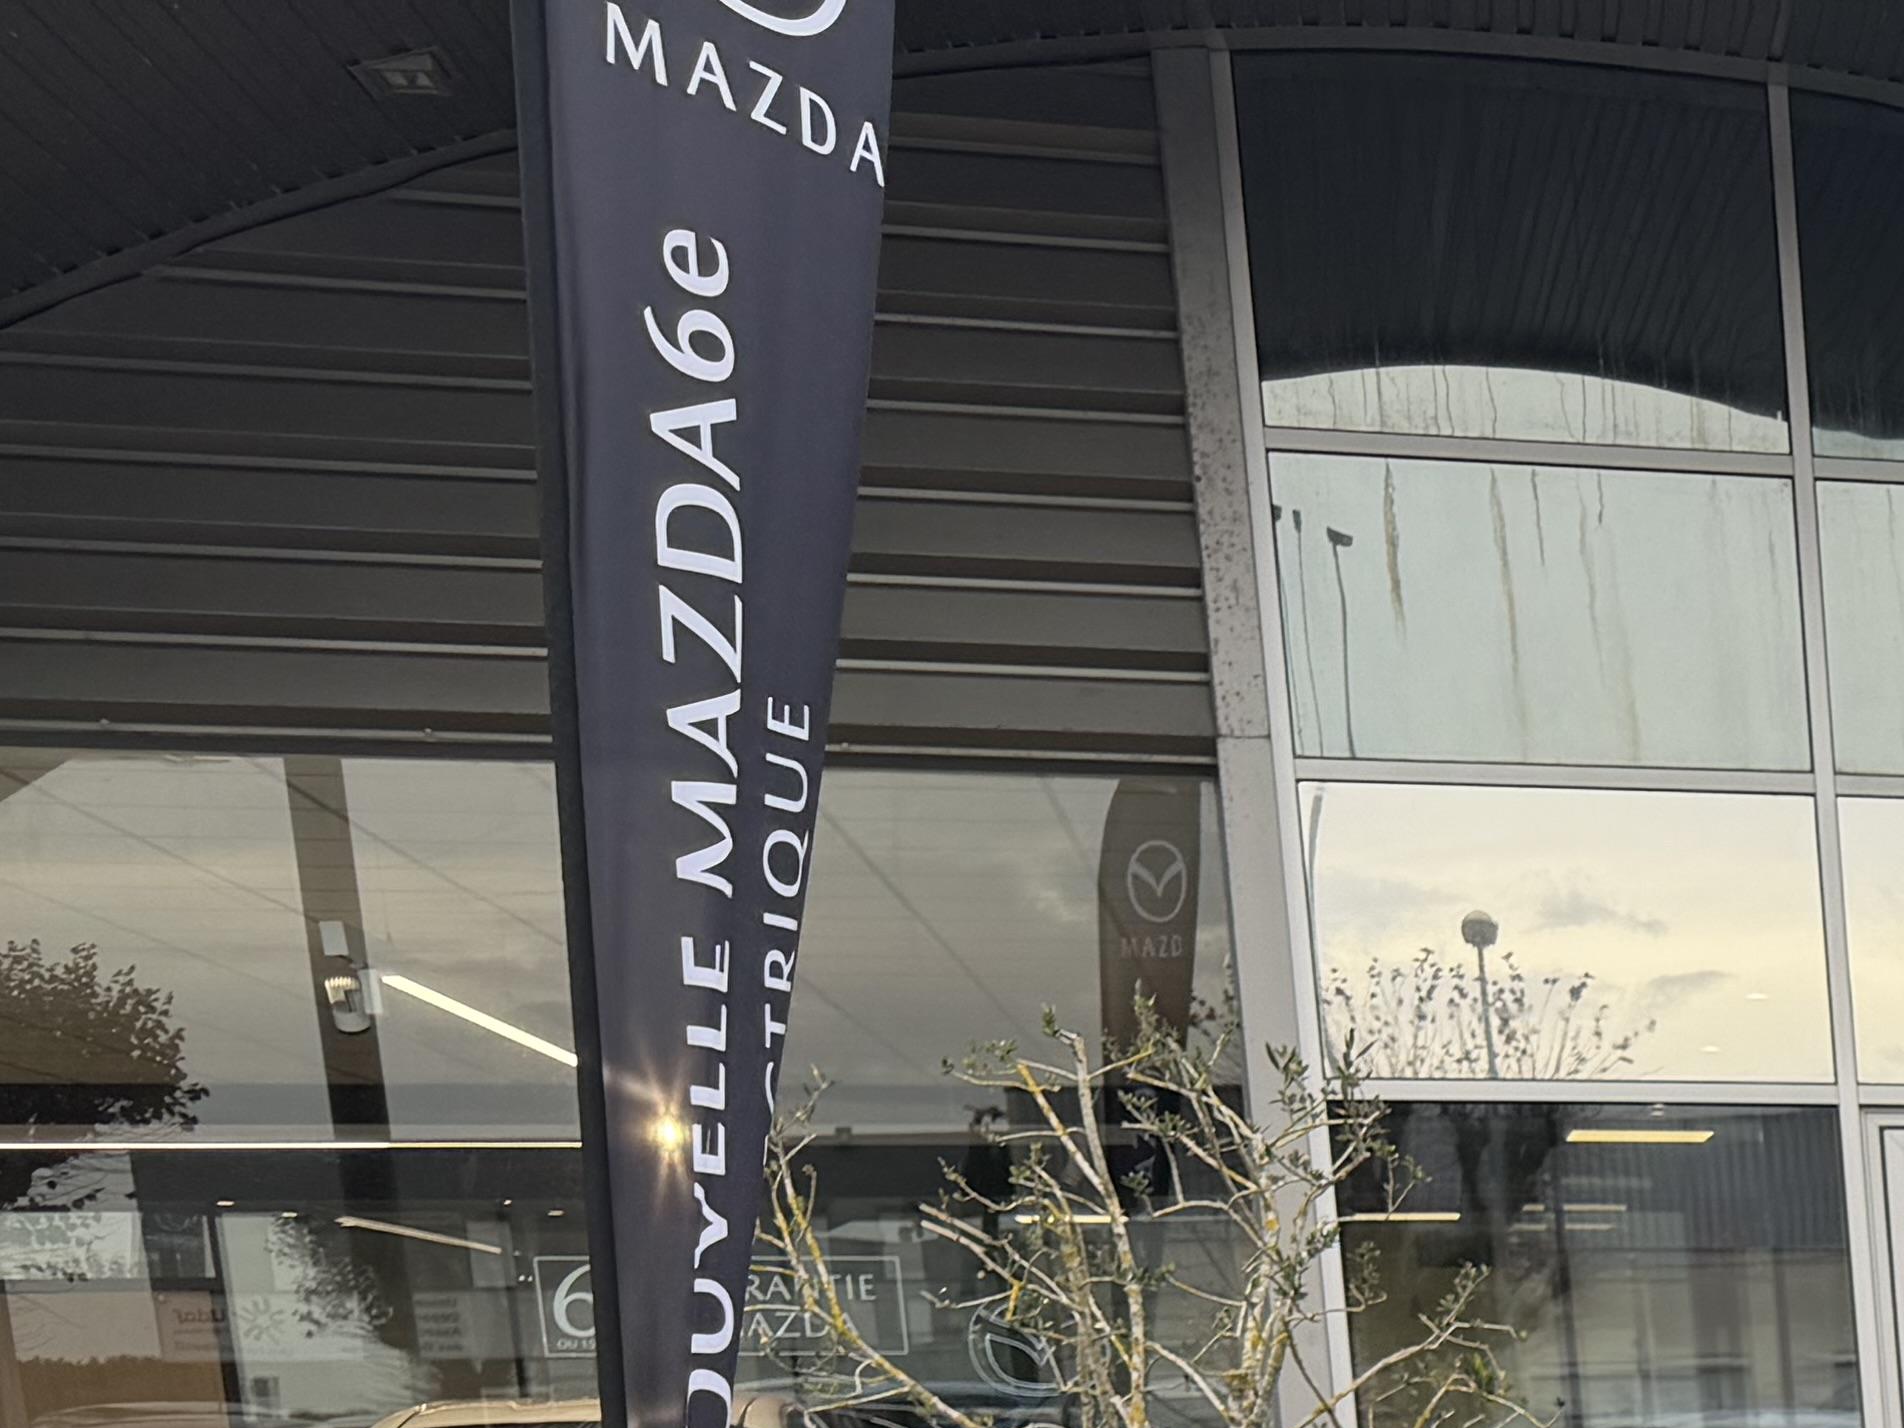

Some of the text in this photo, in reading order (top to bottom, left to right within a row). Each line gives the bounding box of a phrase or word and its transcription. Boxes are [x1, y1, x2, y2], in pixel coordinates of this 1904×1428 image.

[605, 1, 885, 188] MAZDA
[643, 228, 744, 899] MAZDA6e
[761, 696, 811, 1166] TRIQUE
[744, 1273, 877, 1301] RANTIE
